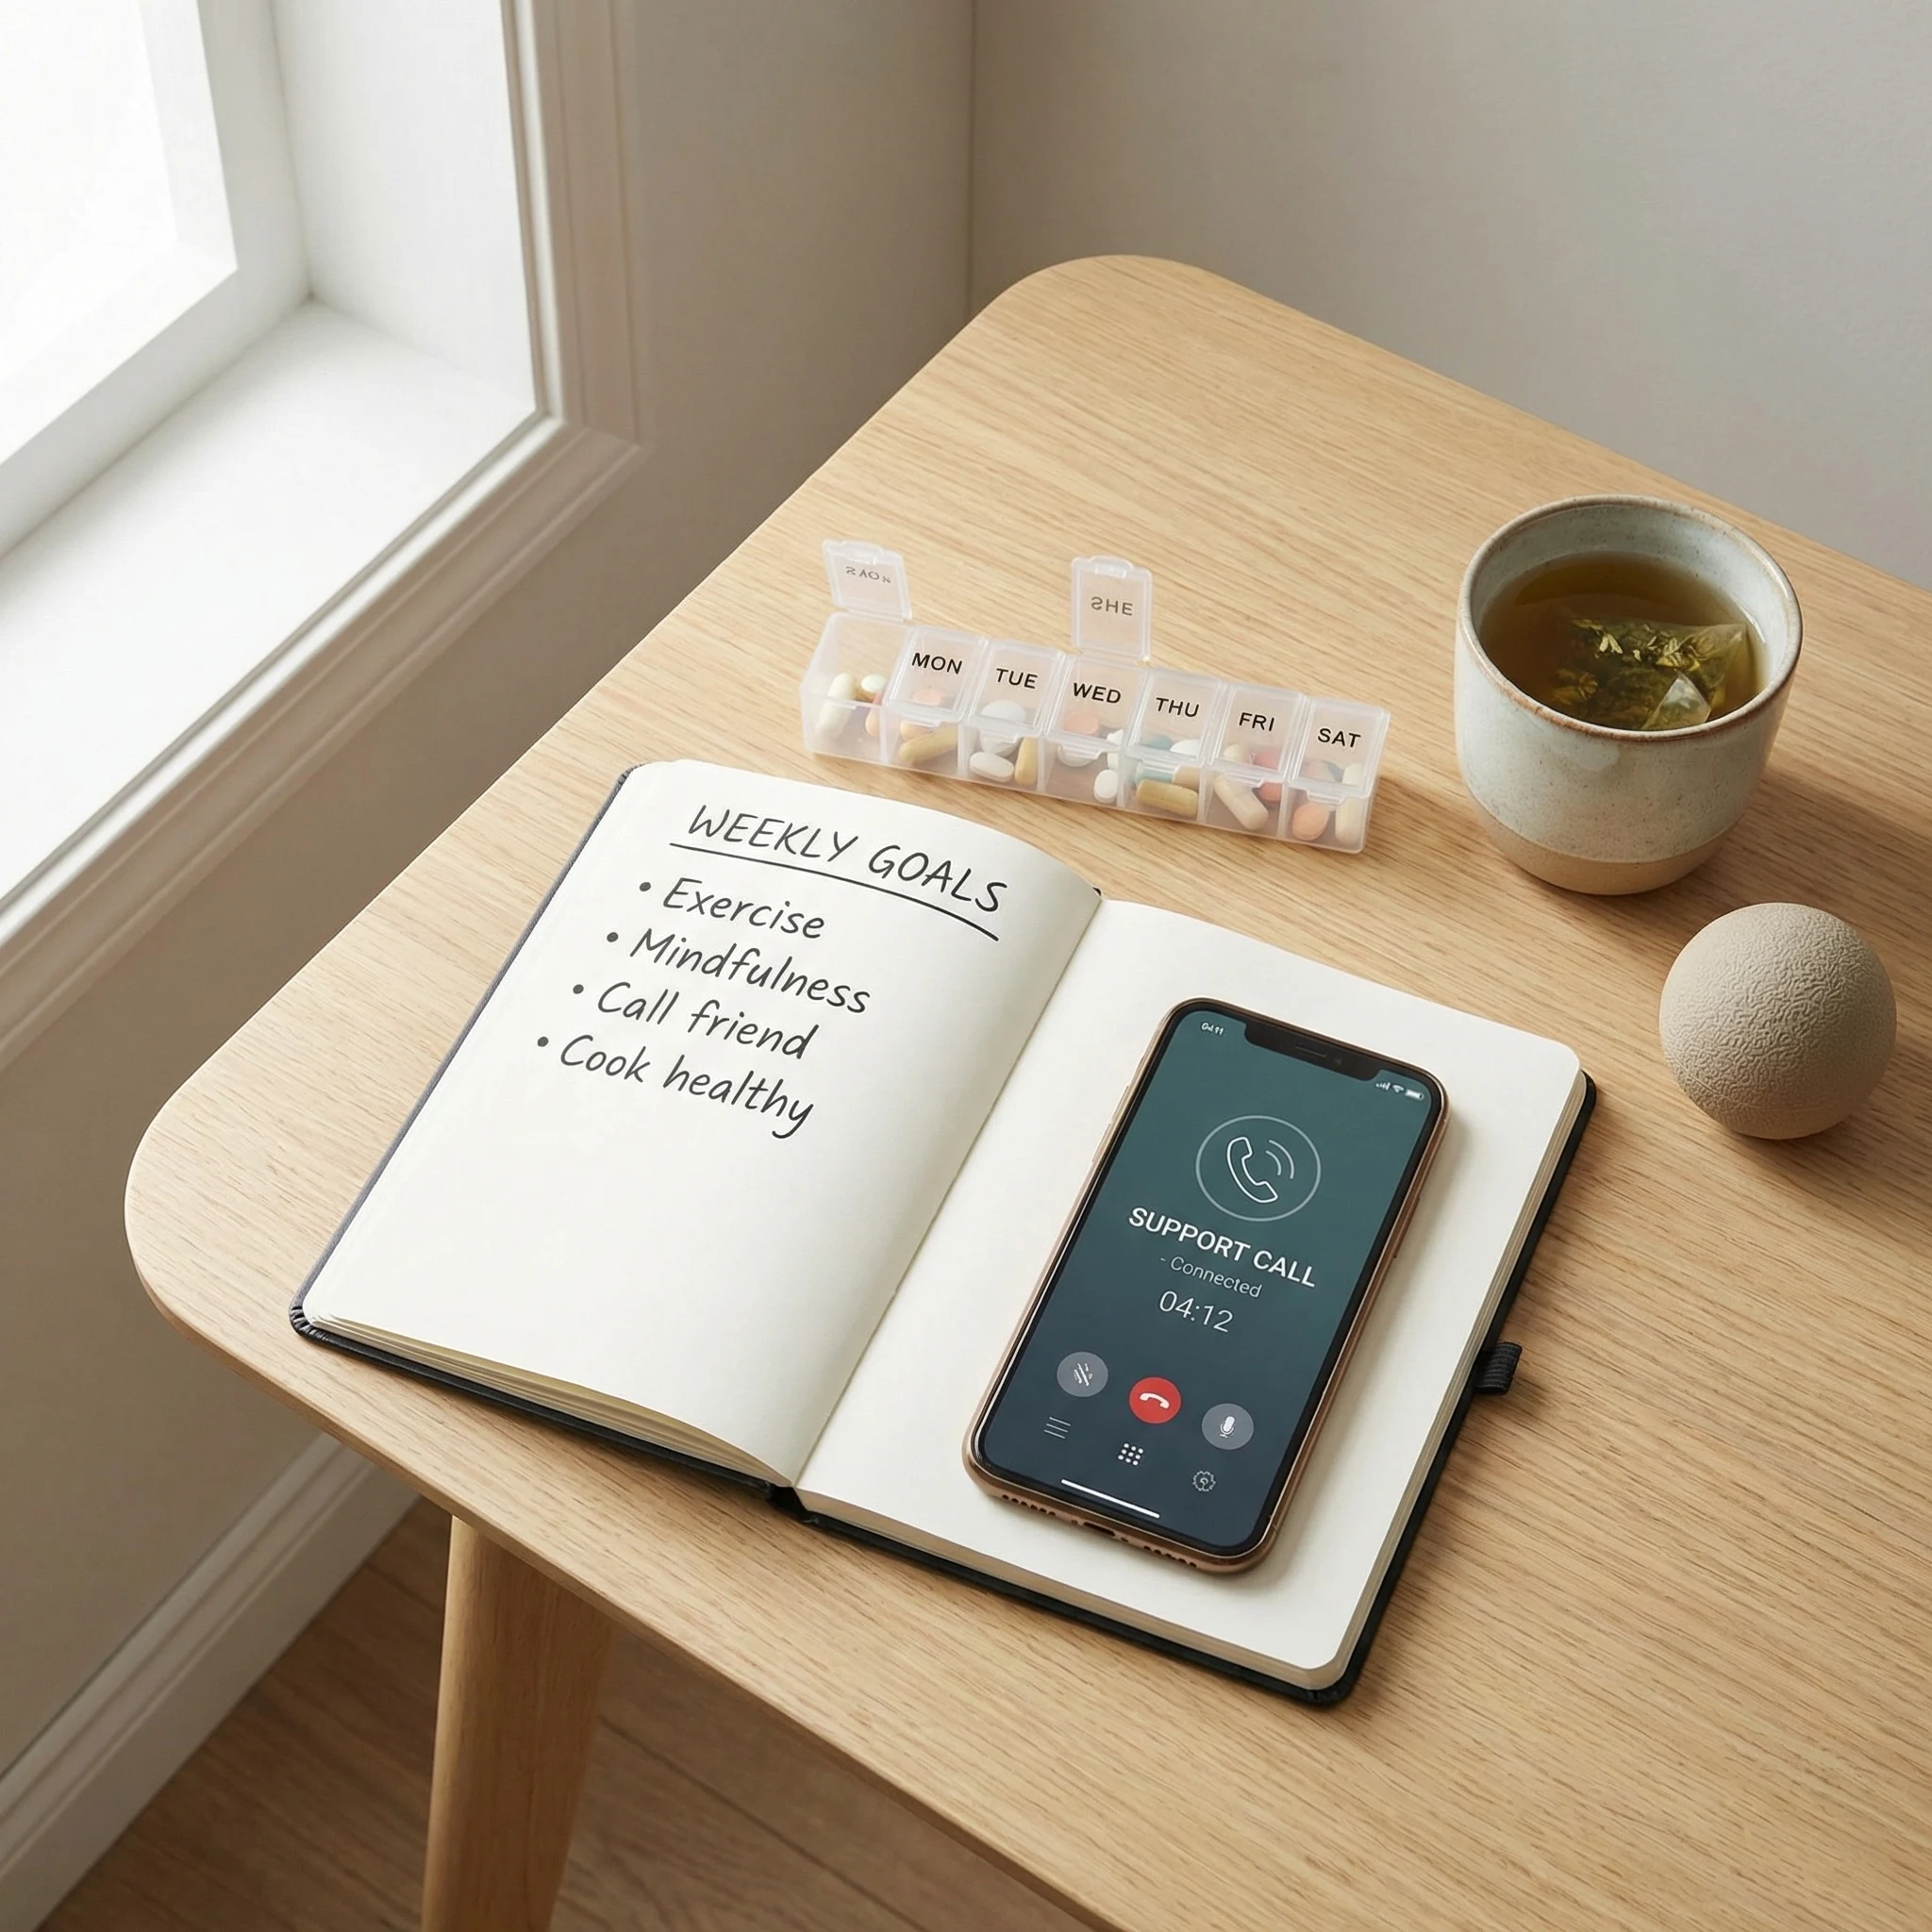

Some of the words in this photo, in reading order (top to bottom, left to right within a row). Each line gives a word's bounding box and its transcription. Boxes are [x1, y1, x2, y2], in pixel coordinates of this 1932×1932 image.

[911, 652, 963, 675] MON
[995, 668, 1039, 690] TUE
[1073, 682, 1123, 704] WED
[1155, 697, 1200, 718] THU
[1239, 712, 1275, 732] FRI
[1317, 727, 1361, 748] SAT
[688, 805, 859, 863] WEEKLY
[867, 844, 1008, 913] GOALS
[662, 877, 825, 940] Exercise
[629, 927, 871, 1014] Mindfulness
[597, 981, 679, 1025] Call
[687, 999, 820, 1060] friend
[559, 1034, 651, 1084] Cook
[662, 1054, 814, 1141] healthy
[1128, 1207, 1251, 1262] SUPPORT
[1253, 1249, 1316, 1289] CALL
[1171, 1256, 1263, 1299] Connected
[1158, 1290, 1234, 1334] 04:12
